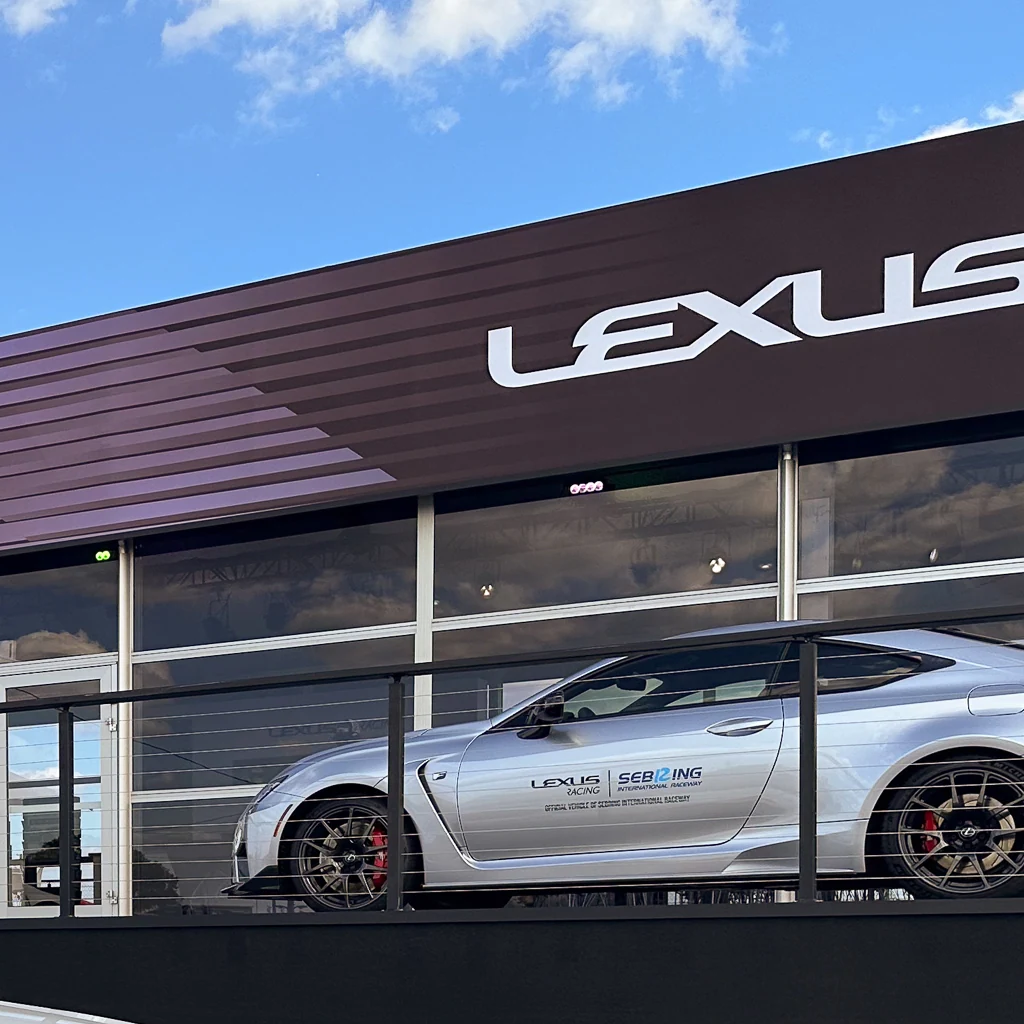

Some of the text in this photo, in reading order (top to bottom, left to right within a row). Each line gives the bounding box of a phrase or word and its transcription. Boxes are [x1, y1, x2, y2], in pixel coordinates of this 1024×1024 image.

[487, 232, 1024, 388] LEXUS
[531, 775, 600, 789] LEXUS
[617, 780, 703, 792] INTERNATIONAL RACEWAY
[567, 786, 600, 796] RACING
